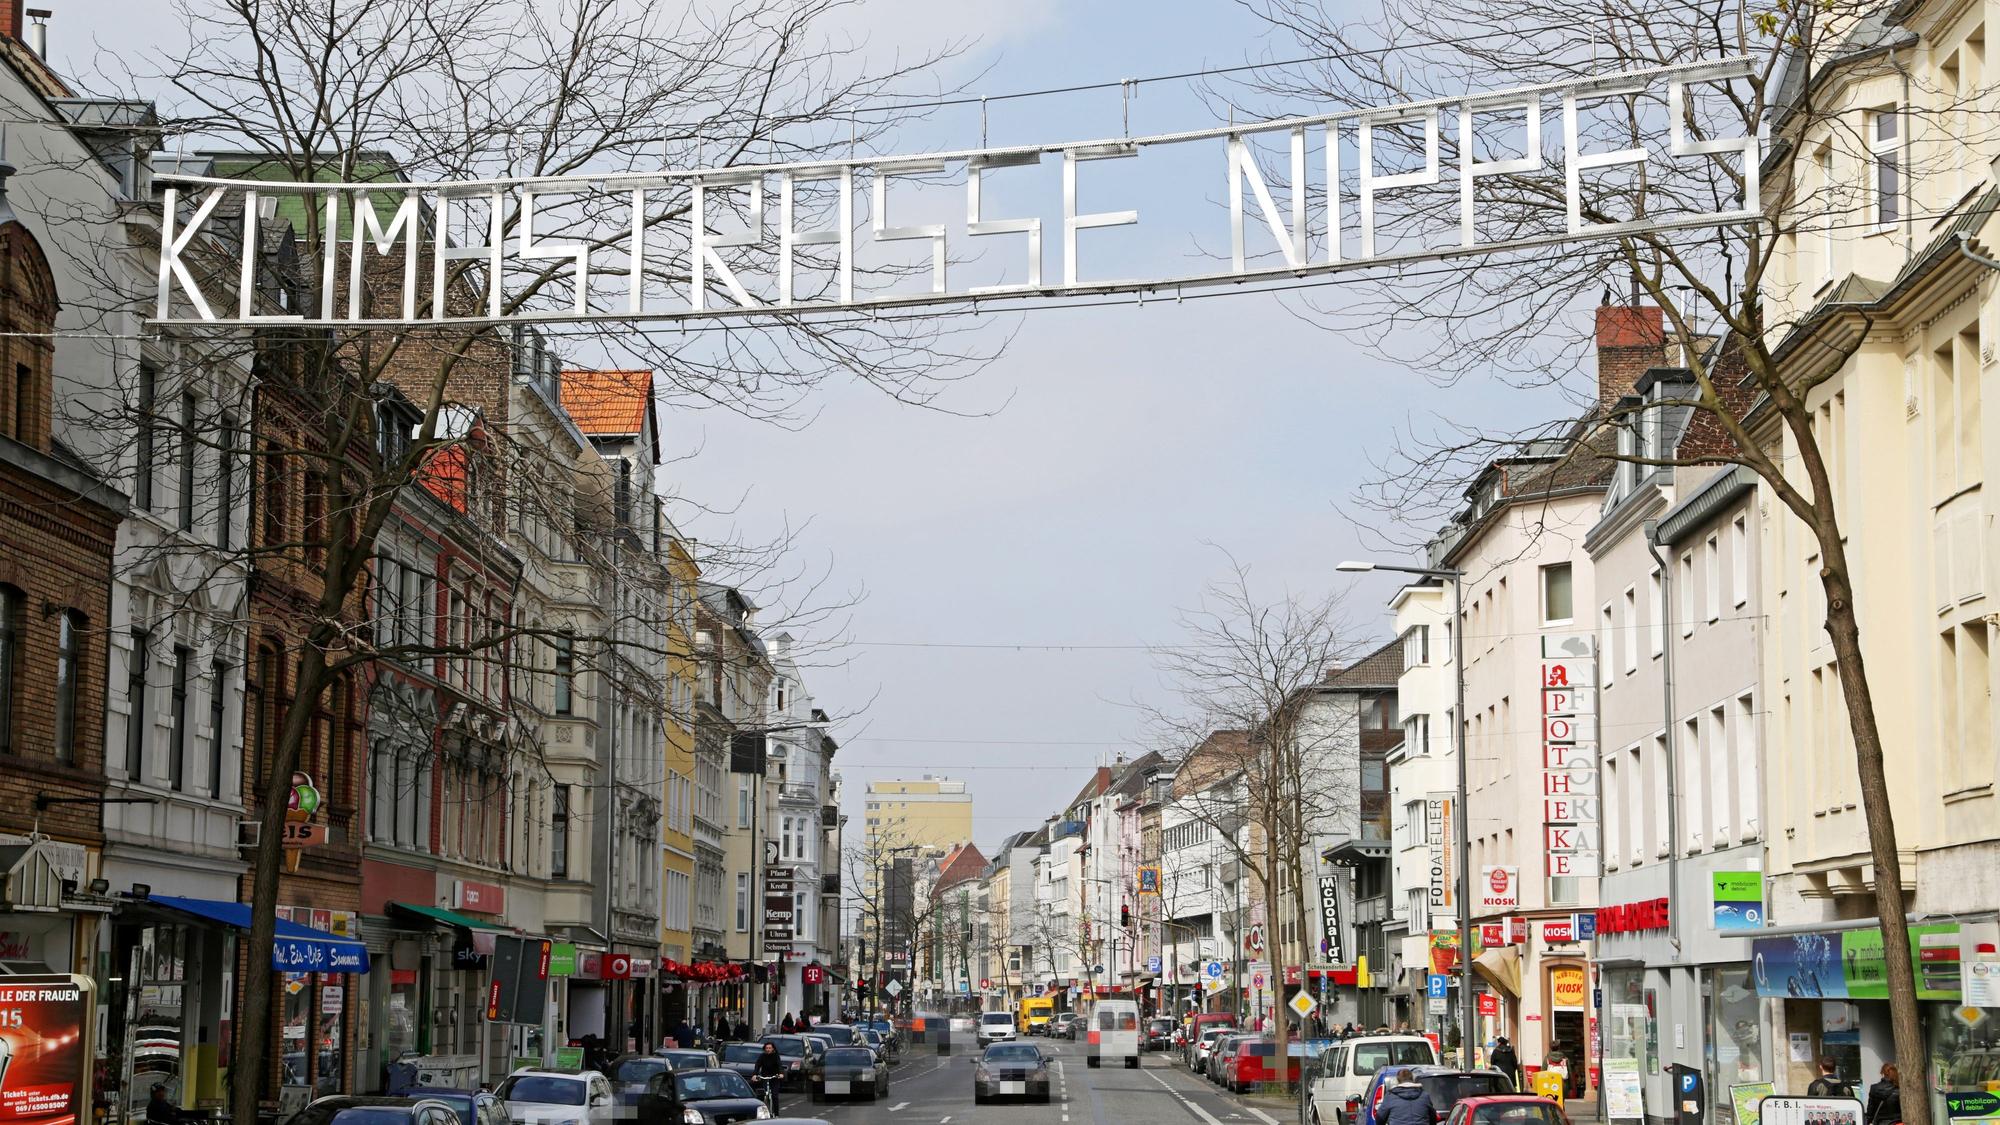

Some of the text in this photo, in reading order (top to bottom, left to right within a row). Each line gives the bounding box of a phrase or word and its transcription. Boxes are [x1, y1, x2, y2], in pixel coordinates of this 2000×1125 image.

[1229, 57, 1762, 274] NIPPES
[1548, 664, 1571, 874] APOTHEKE
[1566, 692, 1595, 858] FLORA
[1430, 800, 1443, 906] FOTOATELIER
[770, 869, 789, 877] Pfand-
[1483, 897, 1515, 906] KIOSK
[766, 909, 792, 920] Kemp
[1320, 878, 1341, 964] McDonald's
[770, 930, 787, 938] Uhren
[1544, 927, 1572, 937] KIOSK
[457, 947, 482, 963] sky
[1556, 983, 1583, 994] KIOSK
[16, 990, 37, 1001] DER
[39, 990, 79, 1001] FRAUEN
[1682, 1075, 1693, 1089] P
[3, 1090, 27, 1098] Tickets
[15, 1104, 28, 1113] 069
